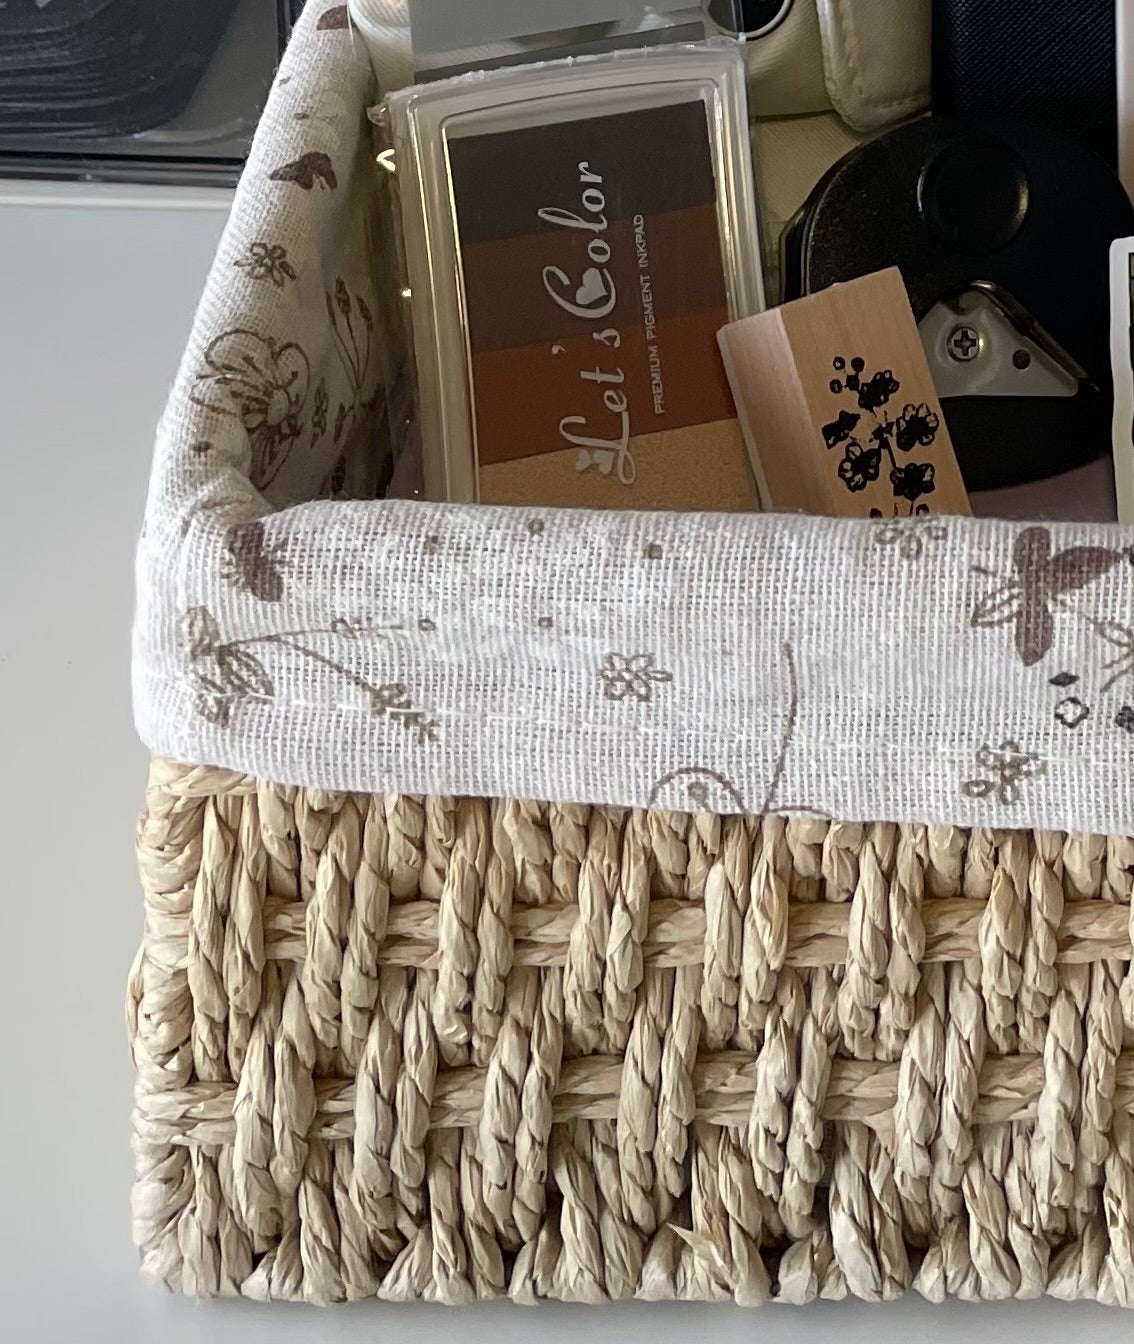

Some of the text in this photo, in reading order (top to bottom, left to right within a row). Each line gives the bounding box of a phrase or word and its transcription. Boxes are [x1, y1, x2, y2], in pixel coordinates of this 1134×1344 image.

[537, 161, 616, 319] Color
[633, 214, 666, 415] PREMIUM PIGMENT INKPAD
